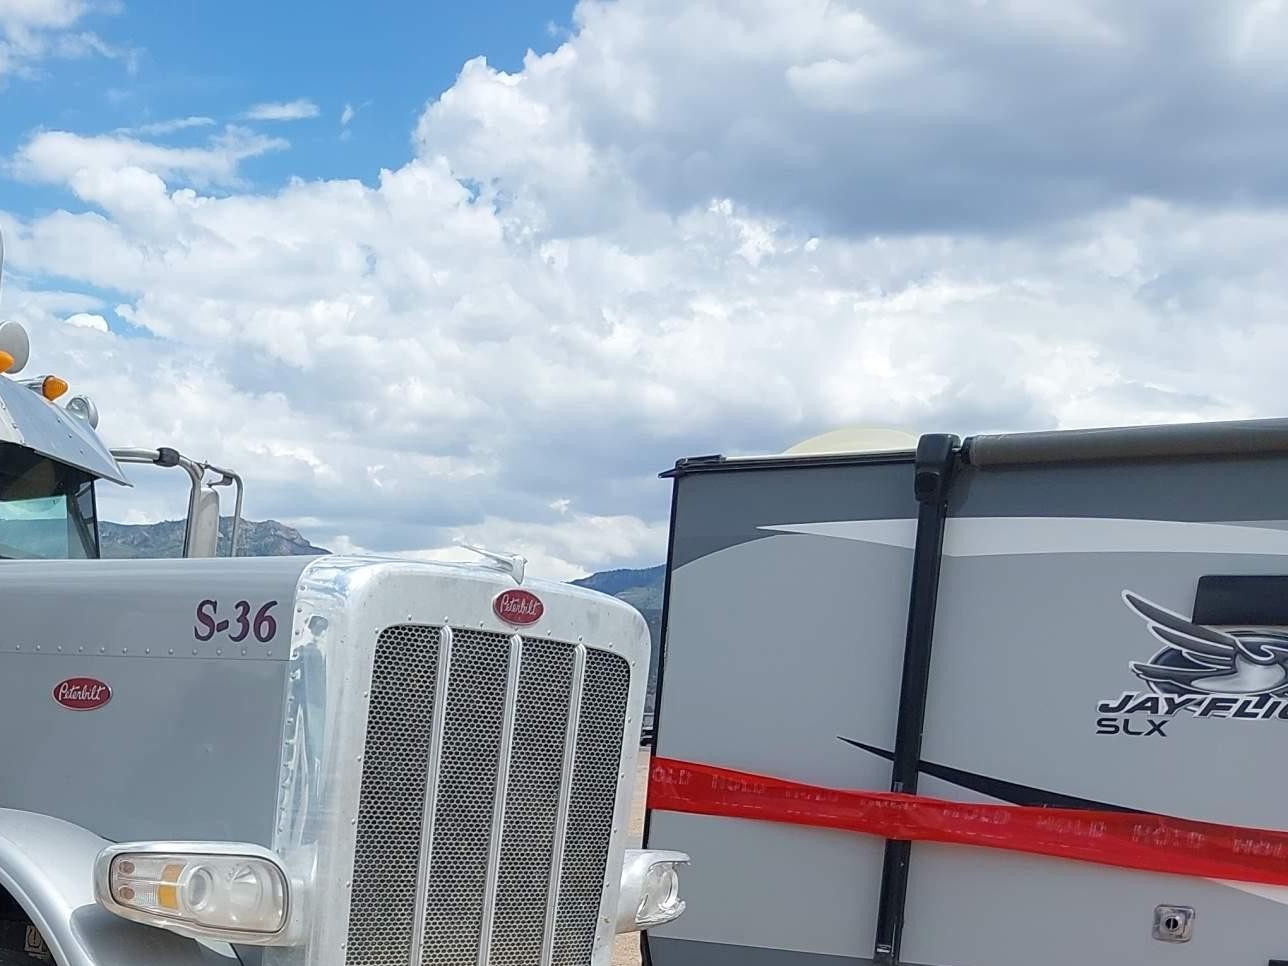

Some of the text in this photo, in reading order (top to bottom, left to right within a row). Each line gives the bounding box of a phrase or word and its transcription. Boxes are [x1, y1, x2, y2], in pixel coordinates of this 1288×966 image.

[499, 593, 541, 616] Peterbilt
[193, 599, 279, 643] S-36
[58, 682, 106, 701] Peterbilt
[1098, 694, 1201, 716] JAY
[1095, 717, 1170, 738] SLX
